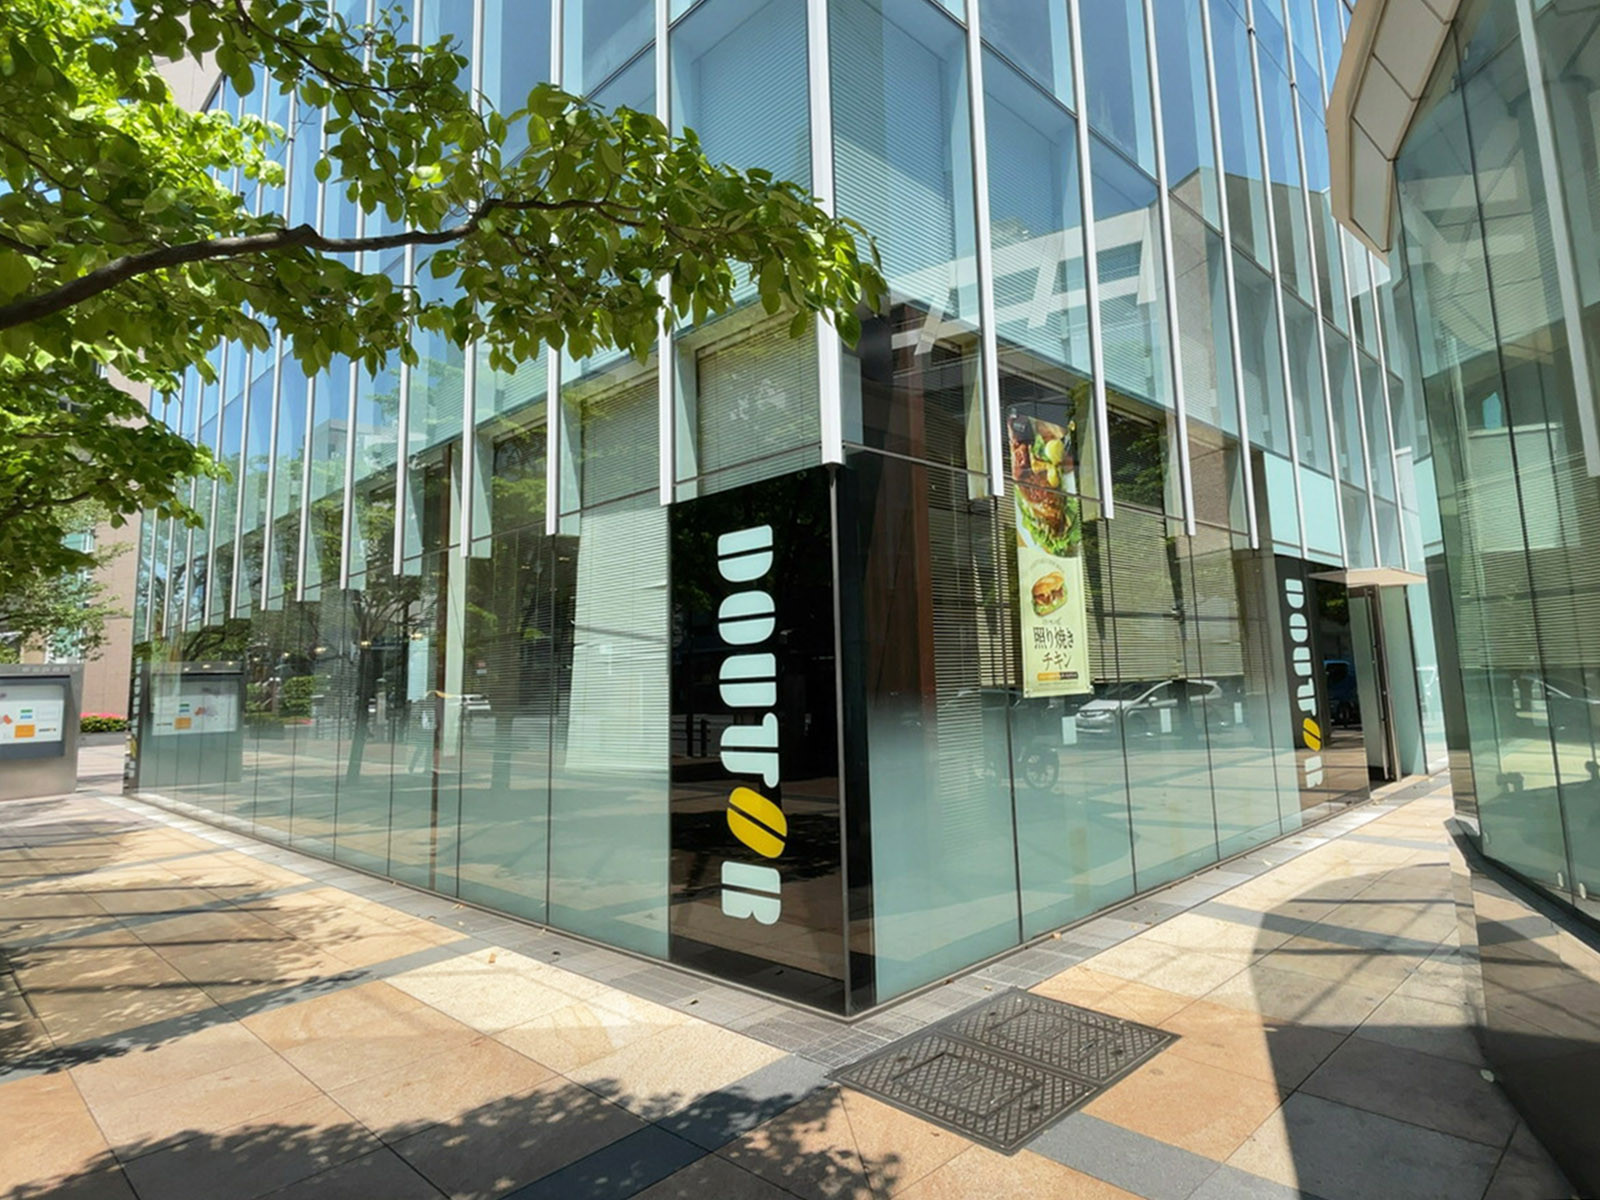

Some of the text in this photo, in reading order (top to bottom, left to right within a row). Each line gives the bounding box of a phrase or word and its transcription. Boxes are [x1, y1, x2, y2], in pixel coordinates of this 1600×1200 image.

[1033, 626, 1074, 649] 照り焼き
[1042, 651, 1072, 671] チキン
[1284, 578, 1324, 789] DOUTOR
[717, 524, 788, 926] DOUTOR
